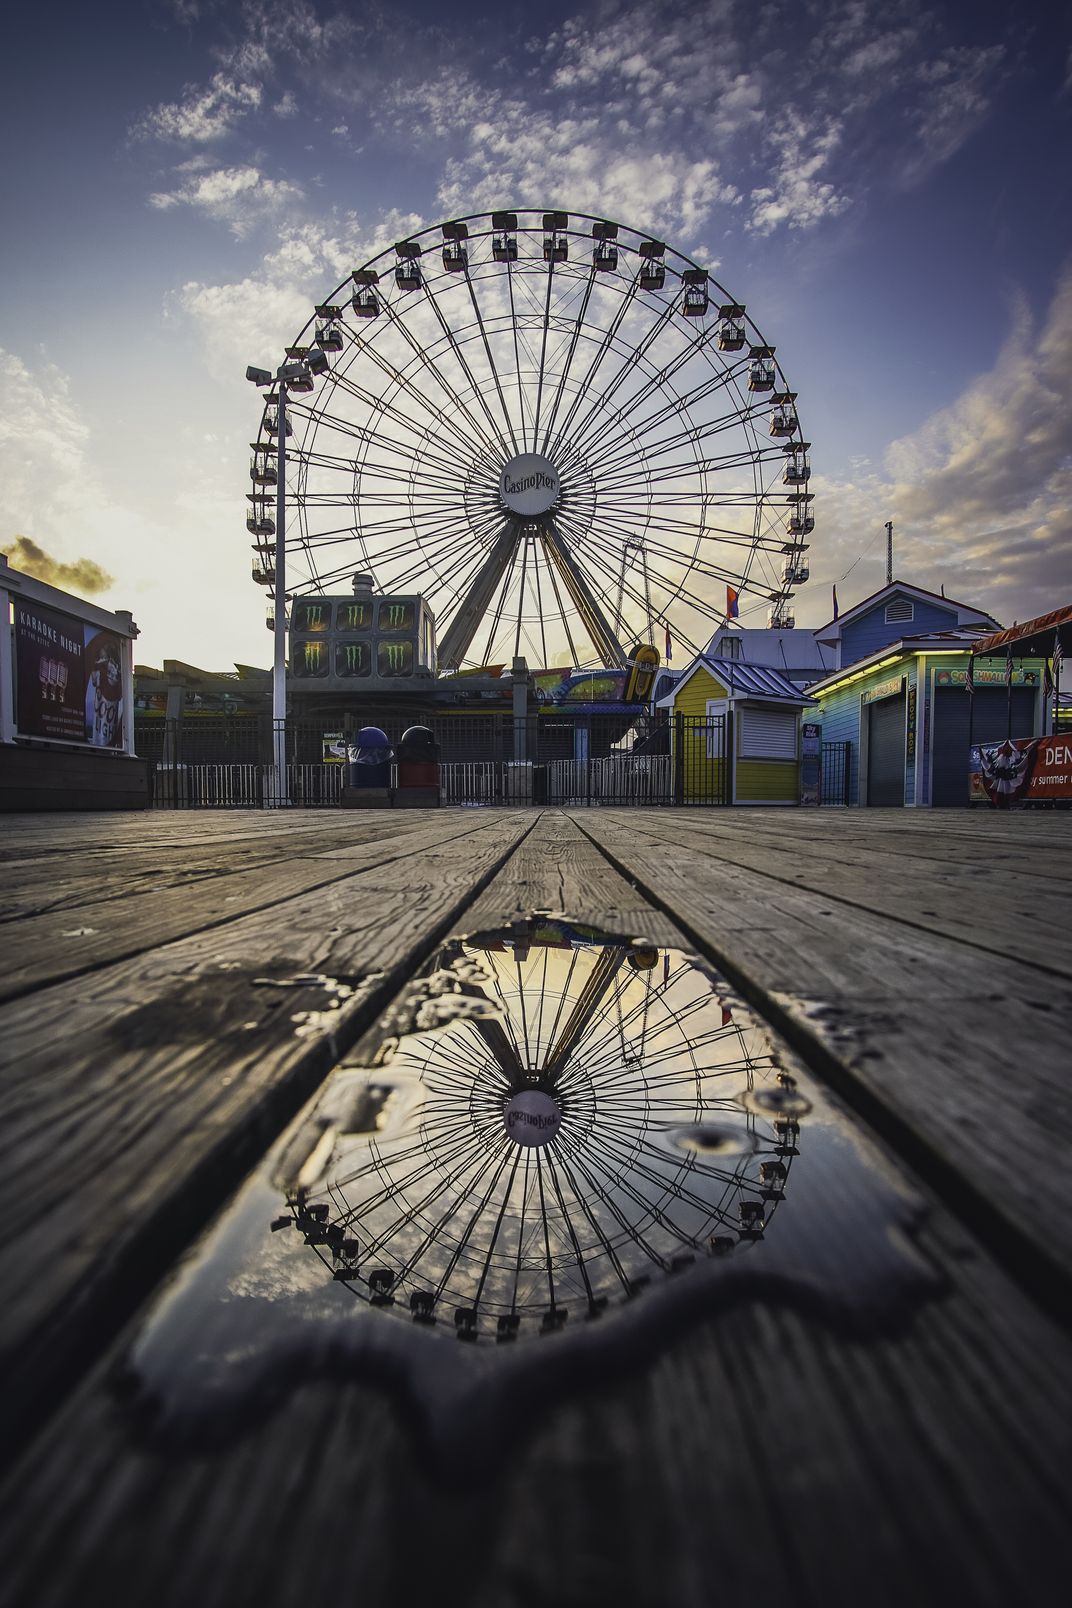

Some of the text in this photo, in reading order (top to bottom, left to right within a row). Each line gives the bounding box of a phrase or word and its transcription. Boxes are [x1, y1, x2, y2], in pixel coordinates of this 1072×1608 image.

[21, 611, 81, 656] KARAOKE NIGHT
[1038, 775, 1067, 785] summer
